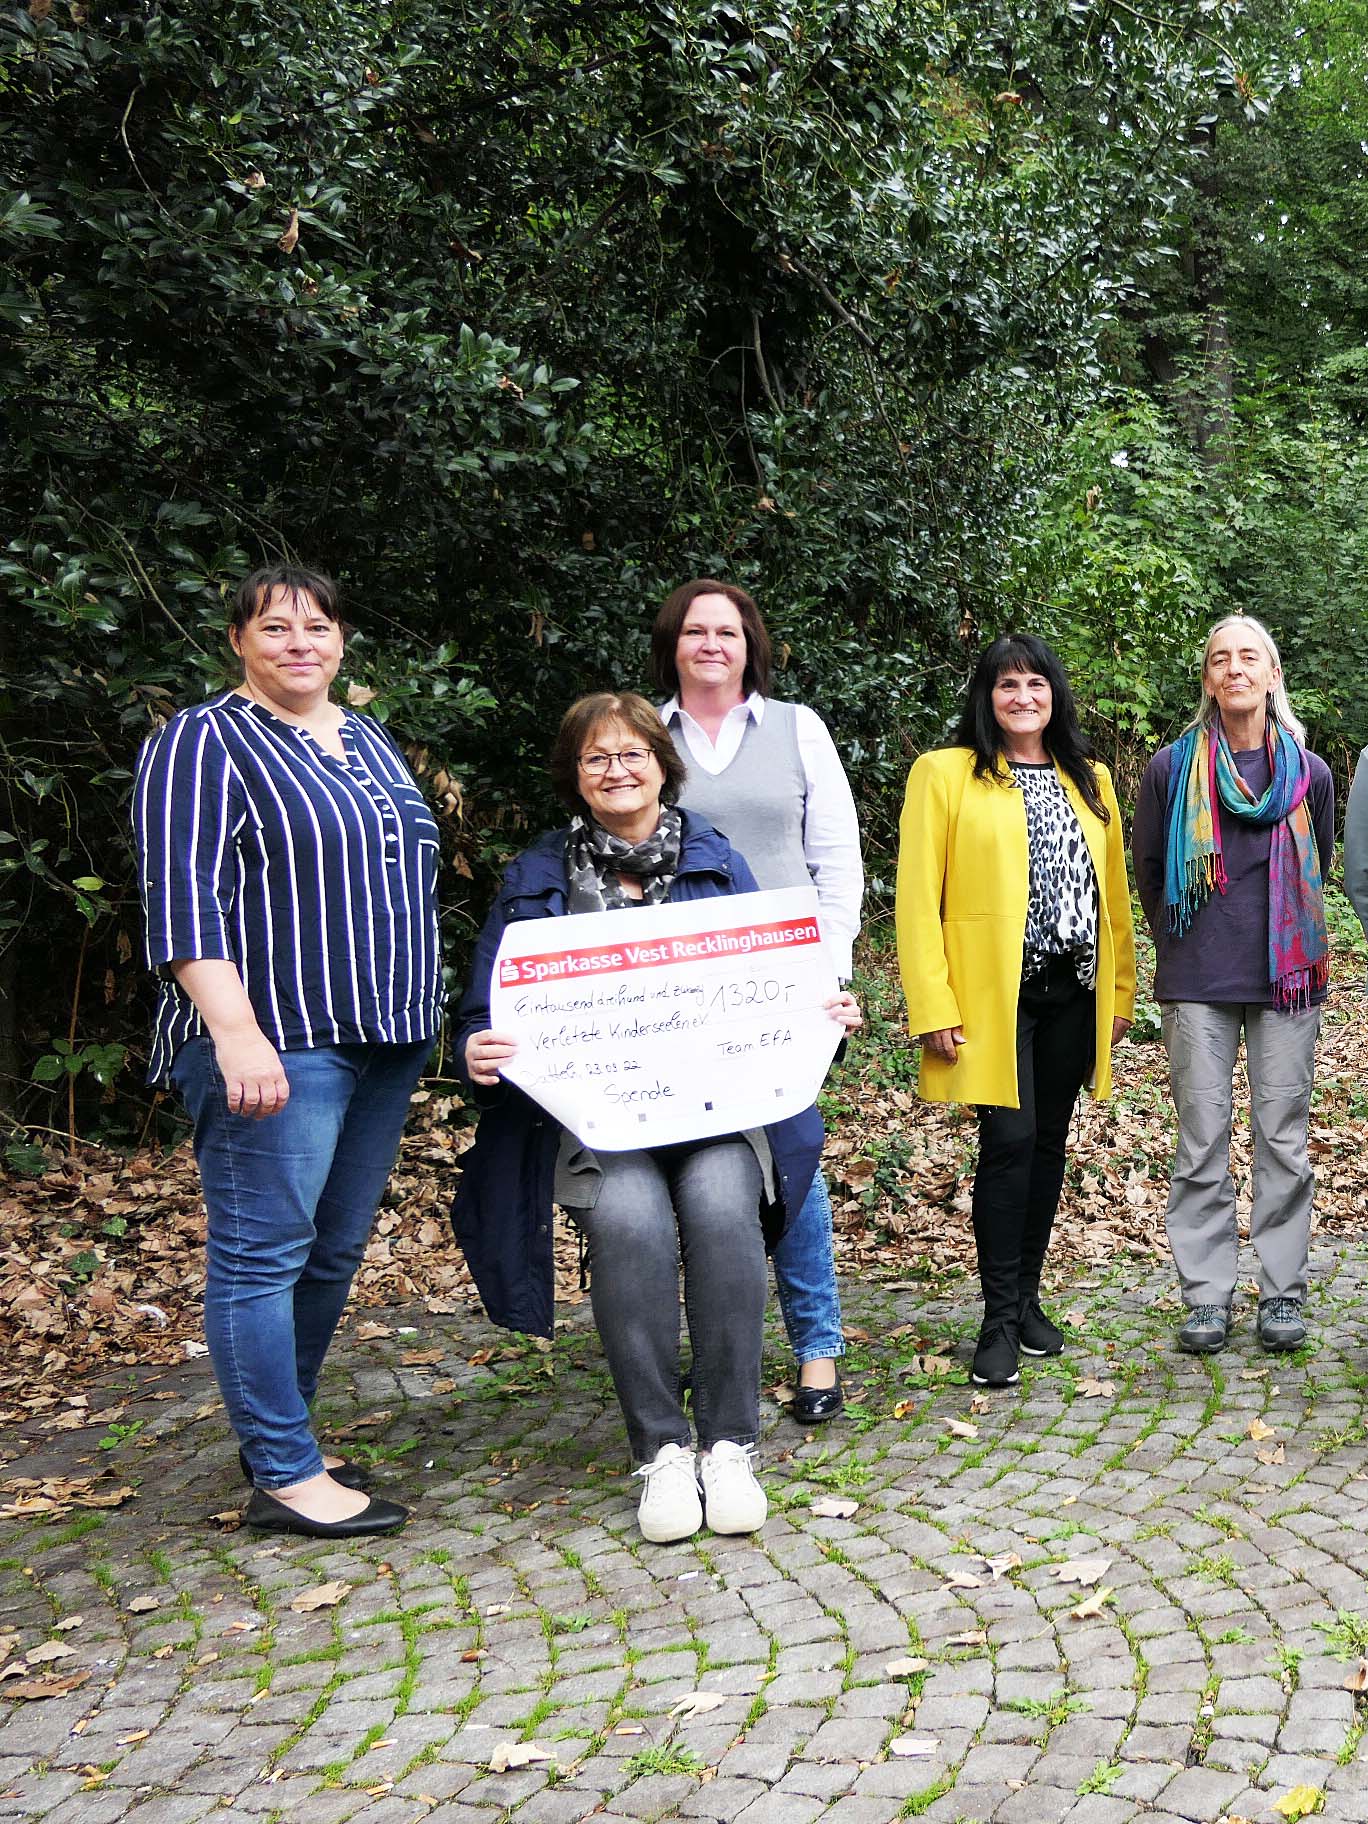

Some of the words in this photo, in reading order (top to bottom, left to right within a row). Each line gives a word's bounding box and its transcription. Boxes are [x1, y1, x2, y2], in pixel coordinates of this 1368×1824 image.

[521, 952, 622, 980] Sparkasse
[625, 944, 668, 964] Vest
[672, 924, 818, 958] Recklinghausen
[717, 1041, 754, 1055] Team
[760, 1029, 792, 1047] EFA
[604, 1080, 677, 1111] Spende
